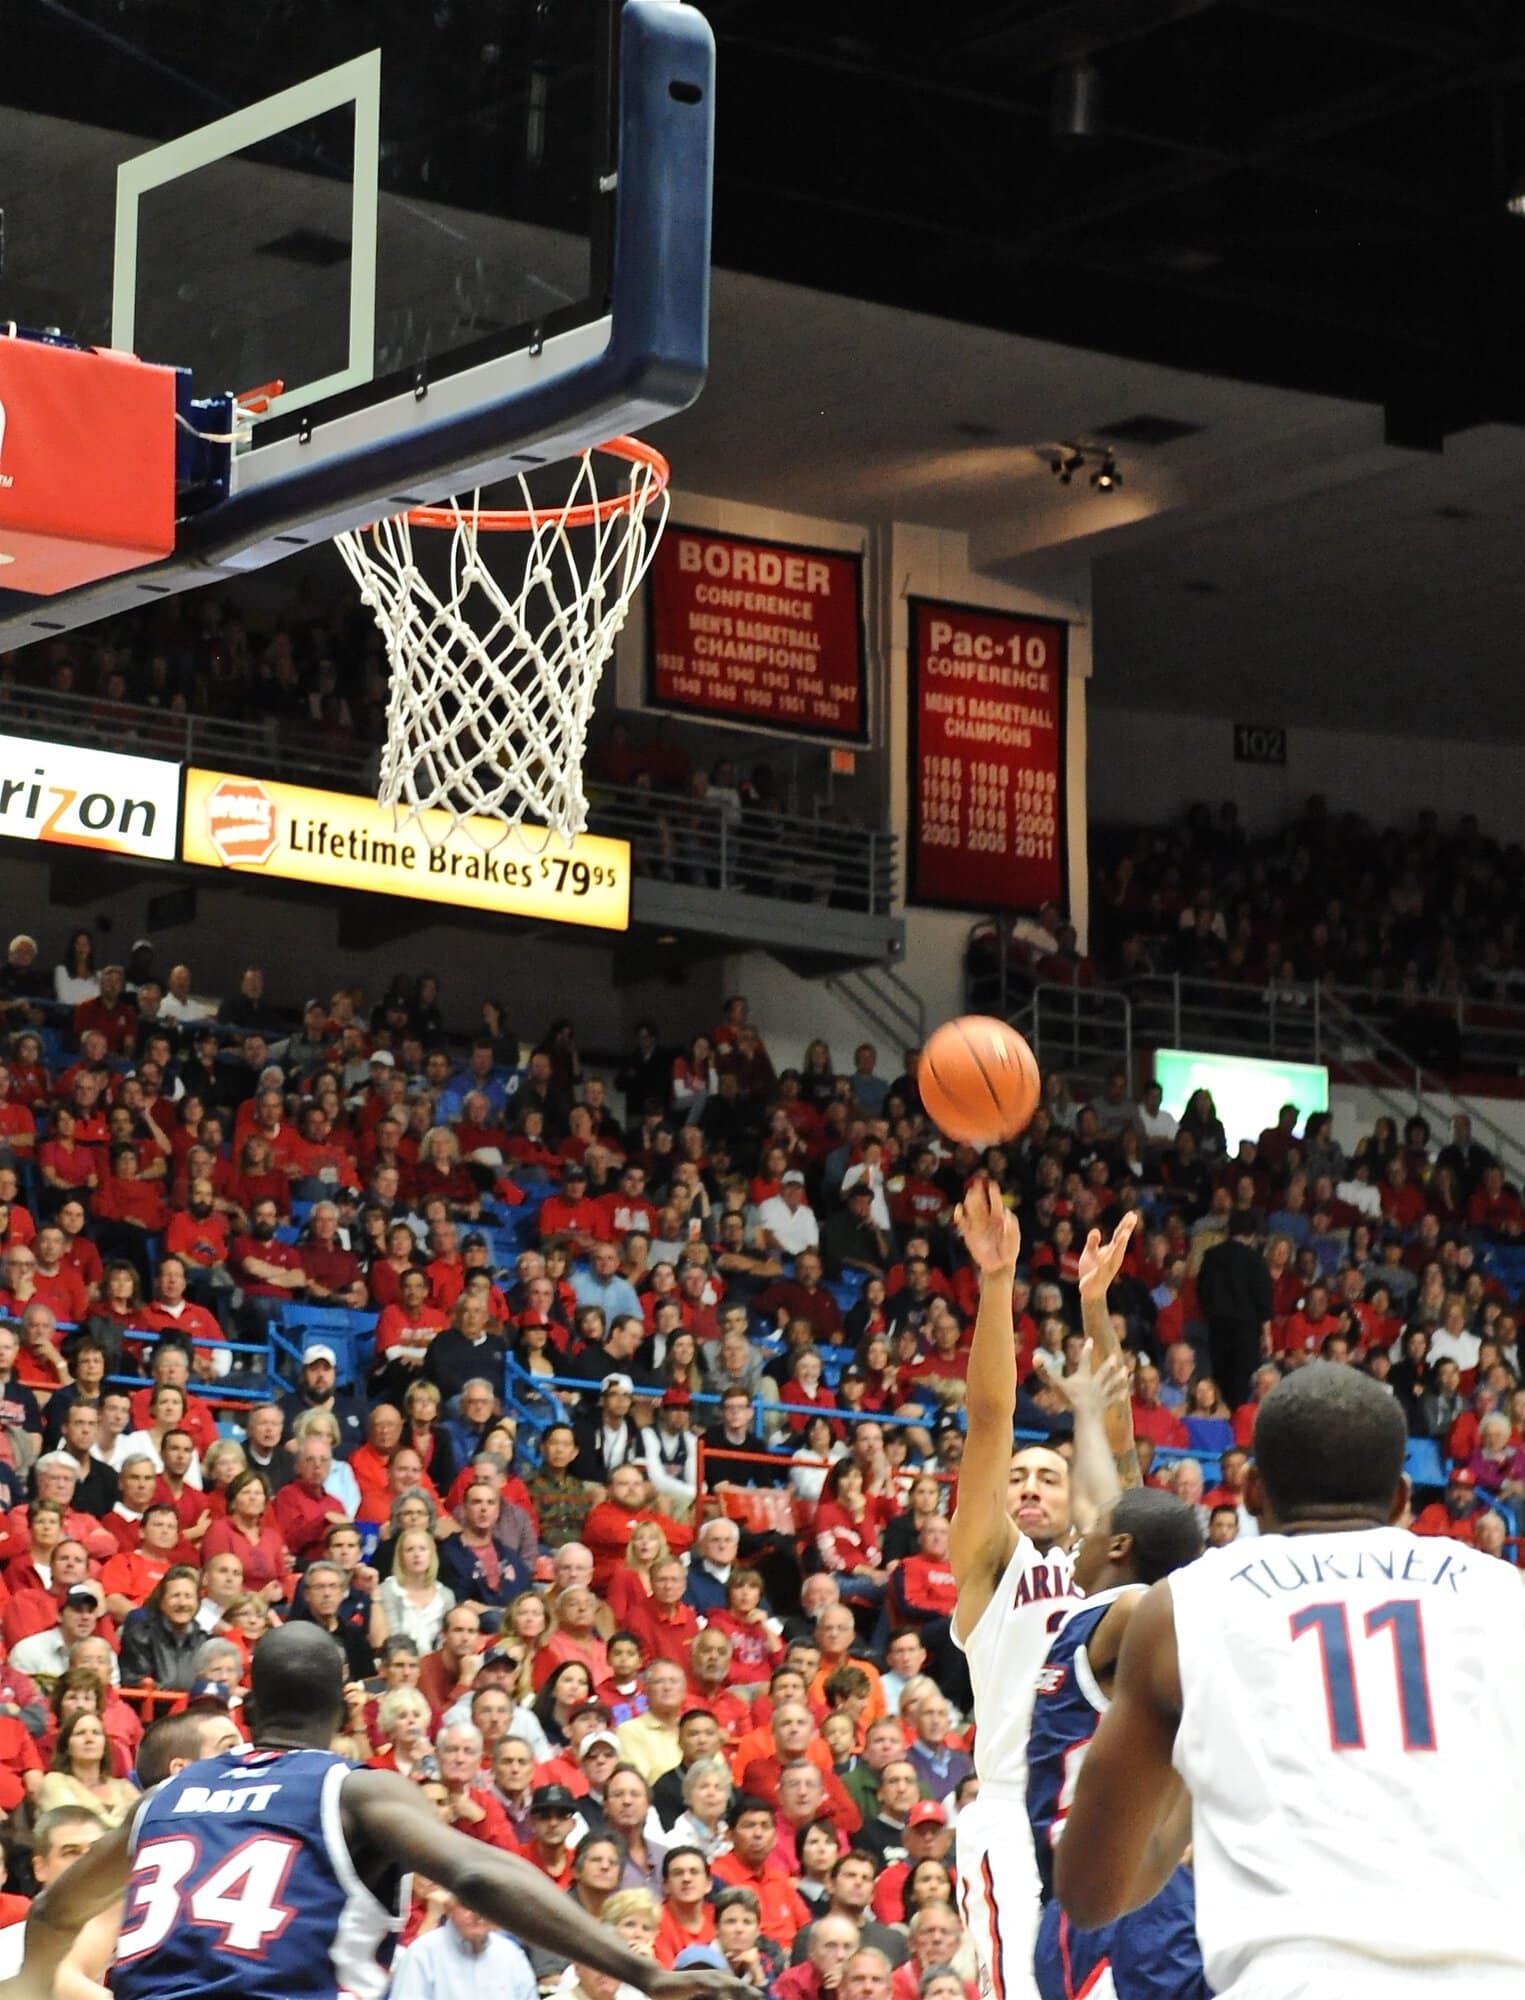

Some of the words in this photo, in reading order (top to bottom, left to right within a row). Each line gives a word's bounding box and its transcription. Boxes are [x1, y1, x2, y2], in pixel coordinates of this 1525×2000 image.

[679, 540, 831, 596] BORDER
[695, 583, 813, 621] CONFERENCE
[689, 611, 733, 636] MEN'S
[736, 619, 820, 651] BASKETBALL
[930, 621, 1046, 669] Pac-10
[694, 636, 817, 672] CHAMPIONS
[927, 656, 1049, 693] CONFERENCE
[925, 692, 965, 716] MEN'S
[968, 697, 1053, 729] BASKETBALL
[944, 717, 1032, 748] CHAMPIONS
[1240, 729, 1281, 757] 102
[970, 784, 1006, 808] 1991
[922, 822, 960, 848] 2003
[1016, 835, 1053, 860] 2011
[1016, 812, 1055, 837] 2000
[290, 819, 416, 870] Lifetime
[429, 846, 532, 888] Brakes
[1230, 1549, 1467, 1599] TURNER
[1289, 1599, 1438, 1753] 11
[172, 1784, 283, 1813] BATT
[114, 1833, 304, 1966] 34
